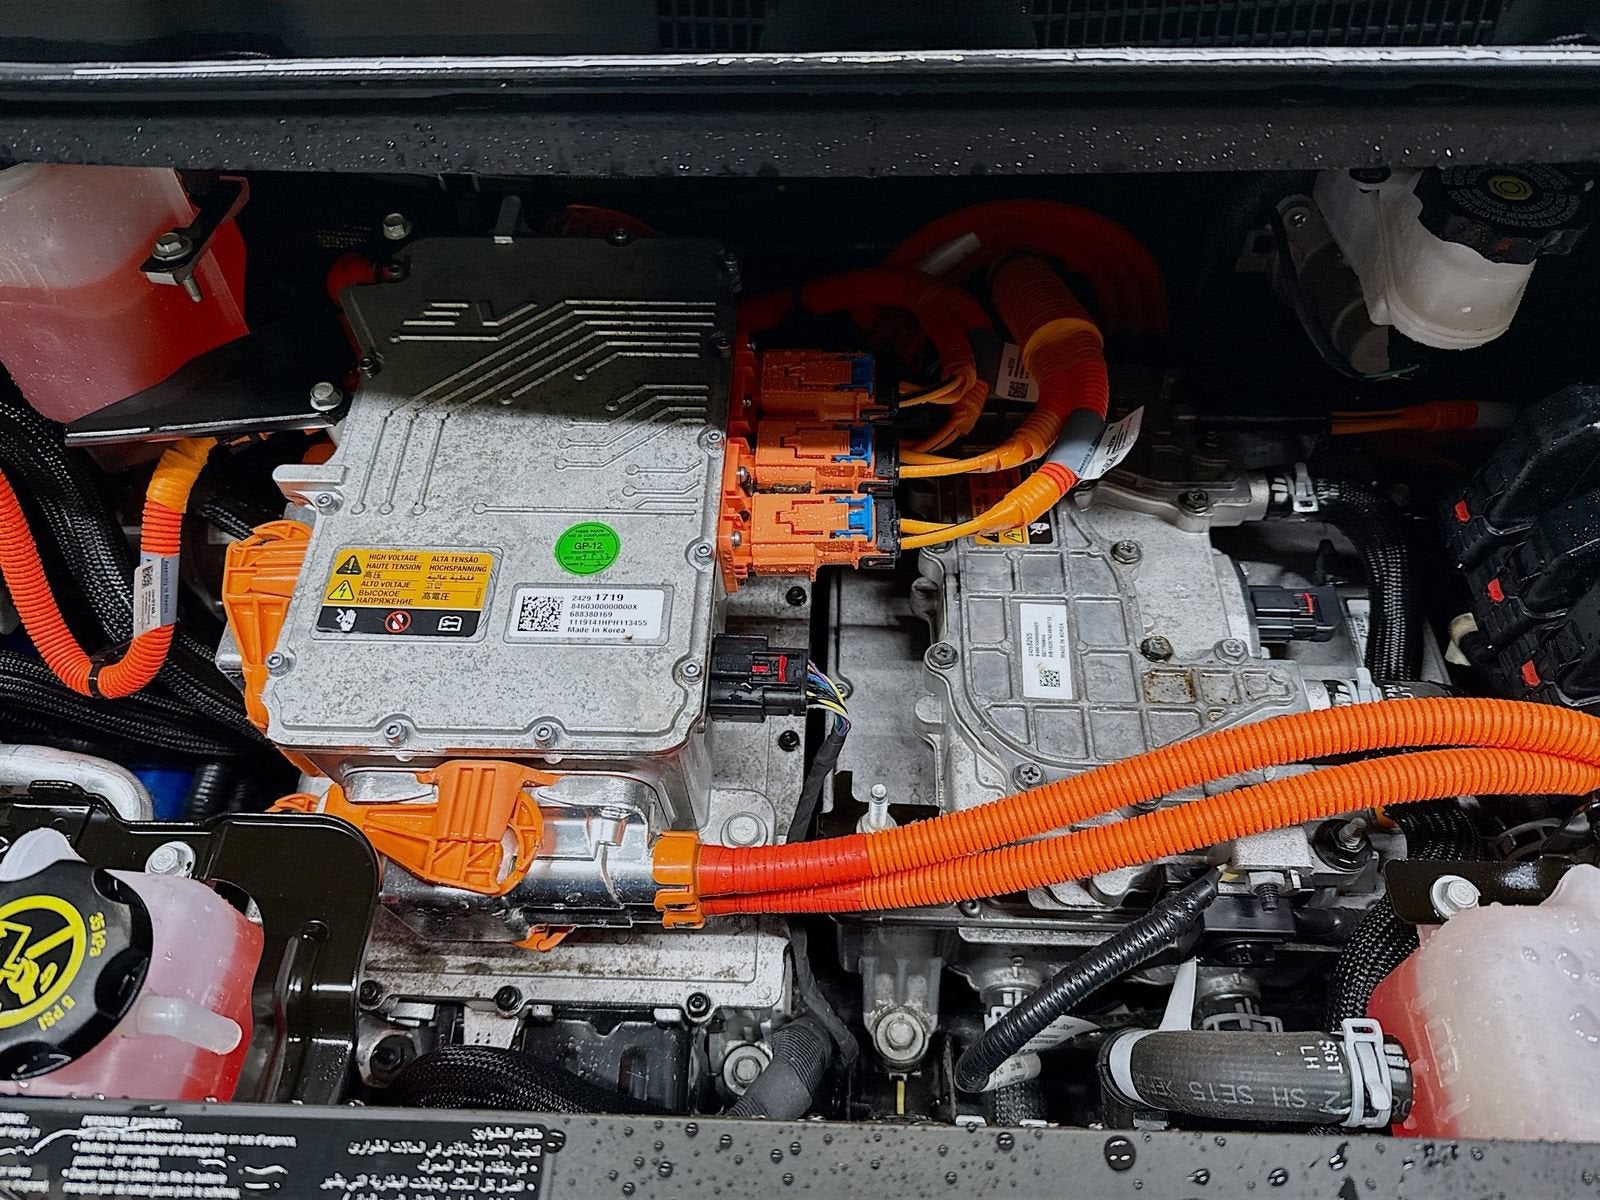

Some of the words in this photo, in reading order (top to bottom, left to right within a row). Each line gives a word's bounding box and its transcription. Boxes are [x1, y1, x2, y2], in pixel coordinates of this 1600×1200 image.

[574, 541, 603, 550] GP-12
[368, 554, 387, 562] HIGH
[387, 554, 419, 562] VOLTAGE
[431, 555, 449, 563] ALTA
[450, 555, 479, 563] TENSÃO
[366, 562, 391, 570] HAUTE
[391, 563, 422, 571] TENSION
[429, 564, 488, 573] HOCHSPANNUNG
[360, 580, 380, 588] ALTO
[380, 581, 412, 589] VOLTAJE
[358, 589, 401, 597] ВЫСОКОЕ
[571, 594, 592, 602] 2429
[595, 593, 625, 602] 1719
[355, 597, 415, 606] НАПРЯЖЕНИЕ
[569, 619, 648, 627] 1119141HPH113455
[567, 626, 590, 634] Made
[1300, 1045, 1321, 1070] LH
[1188, 1081, 1253, 1105] SE15
[1271, 1085, 1306, 1109] SH
